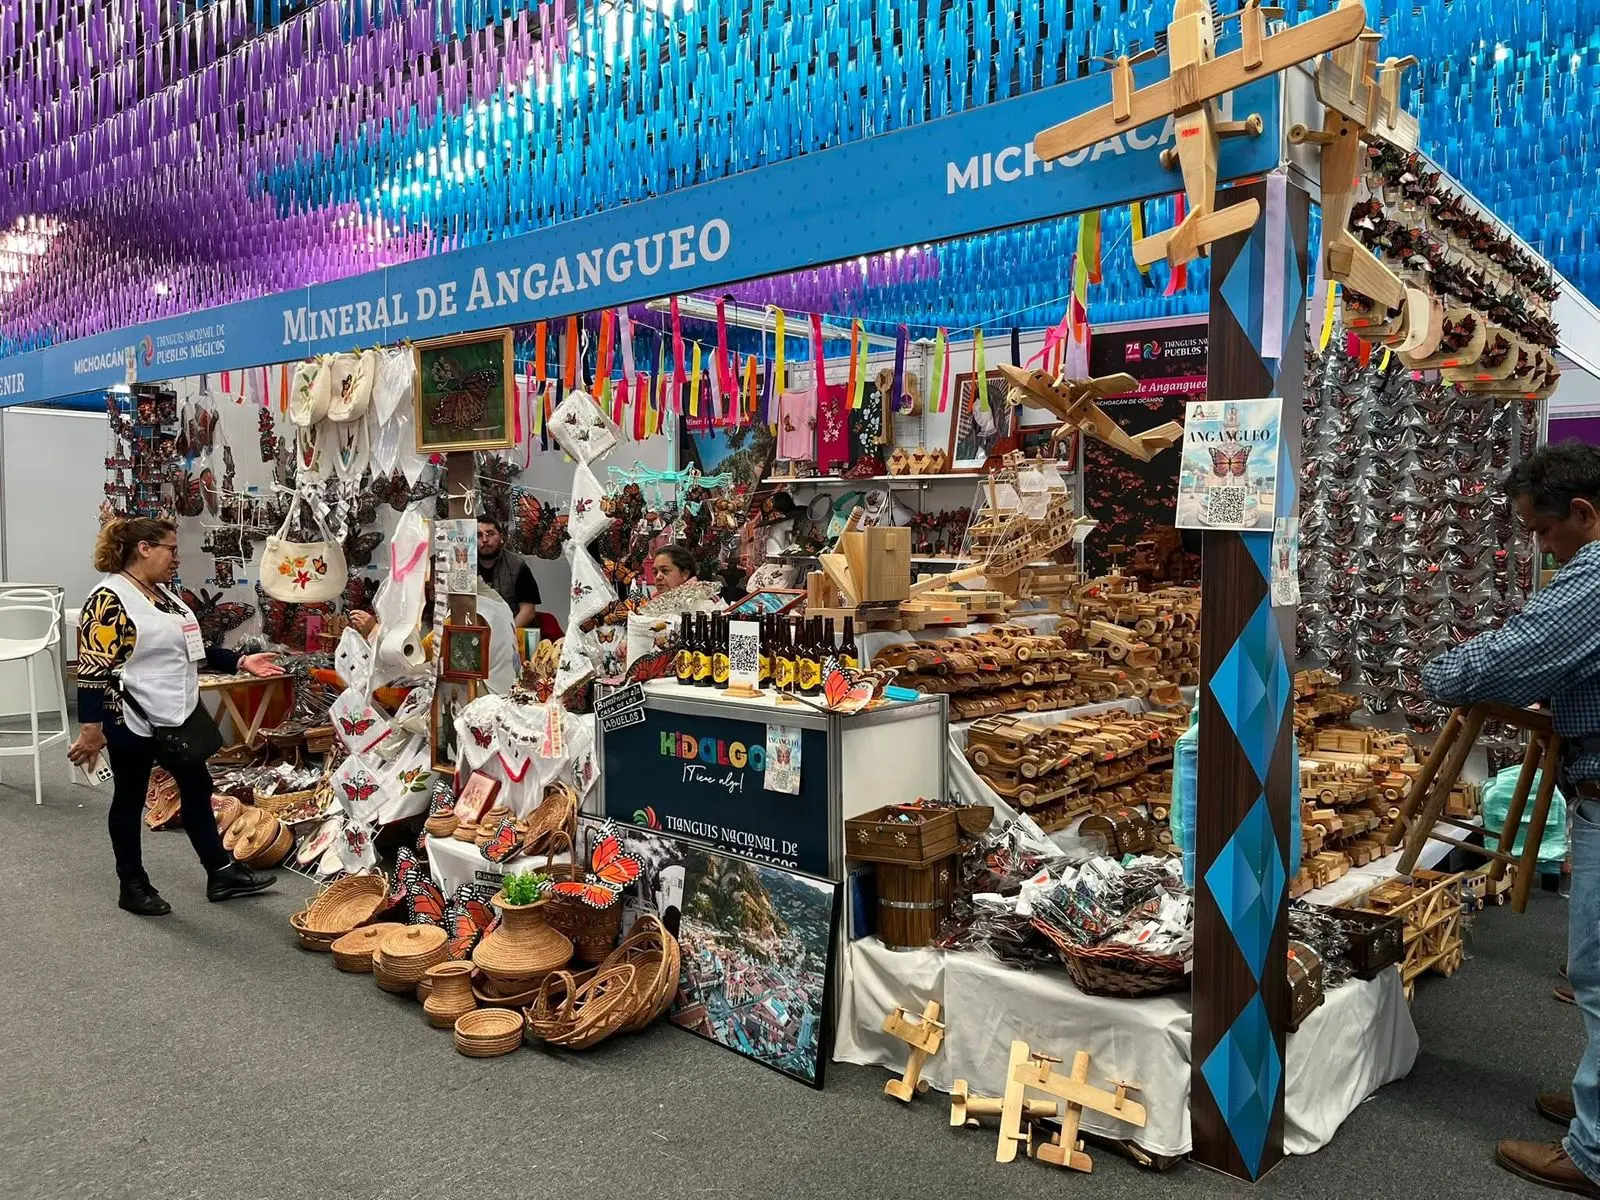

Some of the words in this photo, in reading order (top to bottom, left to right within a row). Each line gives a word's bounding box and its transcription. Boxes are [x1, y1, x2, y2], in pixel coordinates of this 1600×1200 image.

[282, 291, 408, 347] MINERAL
[416, 281, 457, 321] DE
[466, 218, 731, 312] ANGANGUEO
[74, 347, 125, 375] MICHOACÁN
[1149, 380, 1207, 395] Angangueo
[1187, 429, 1271, 443] ANGANGUEO
[600, 706, 616, 717] CASA
[625, 697, 637, 705] LOS
[605, 711, 639, 729] ABUELOS
[718, 771, 745, 794] algo!
